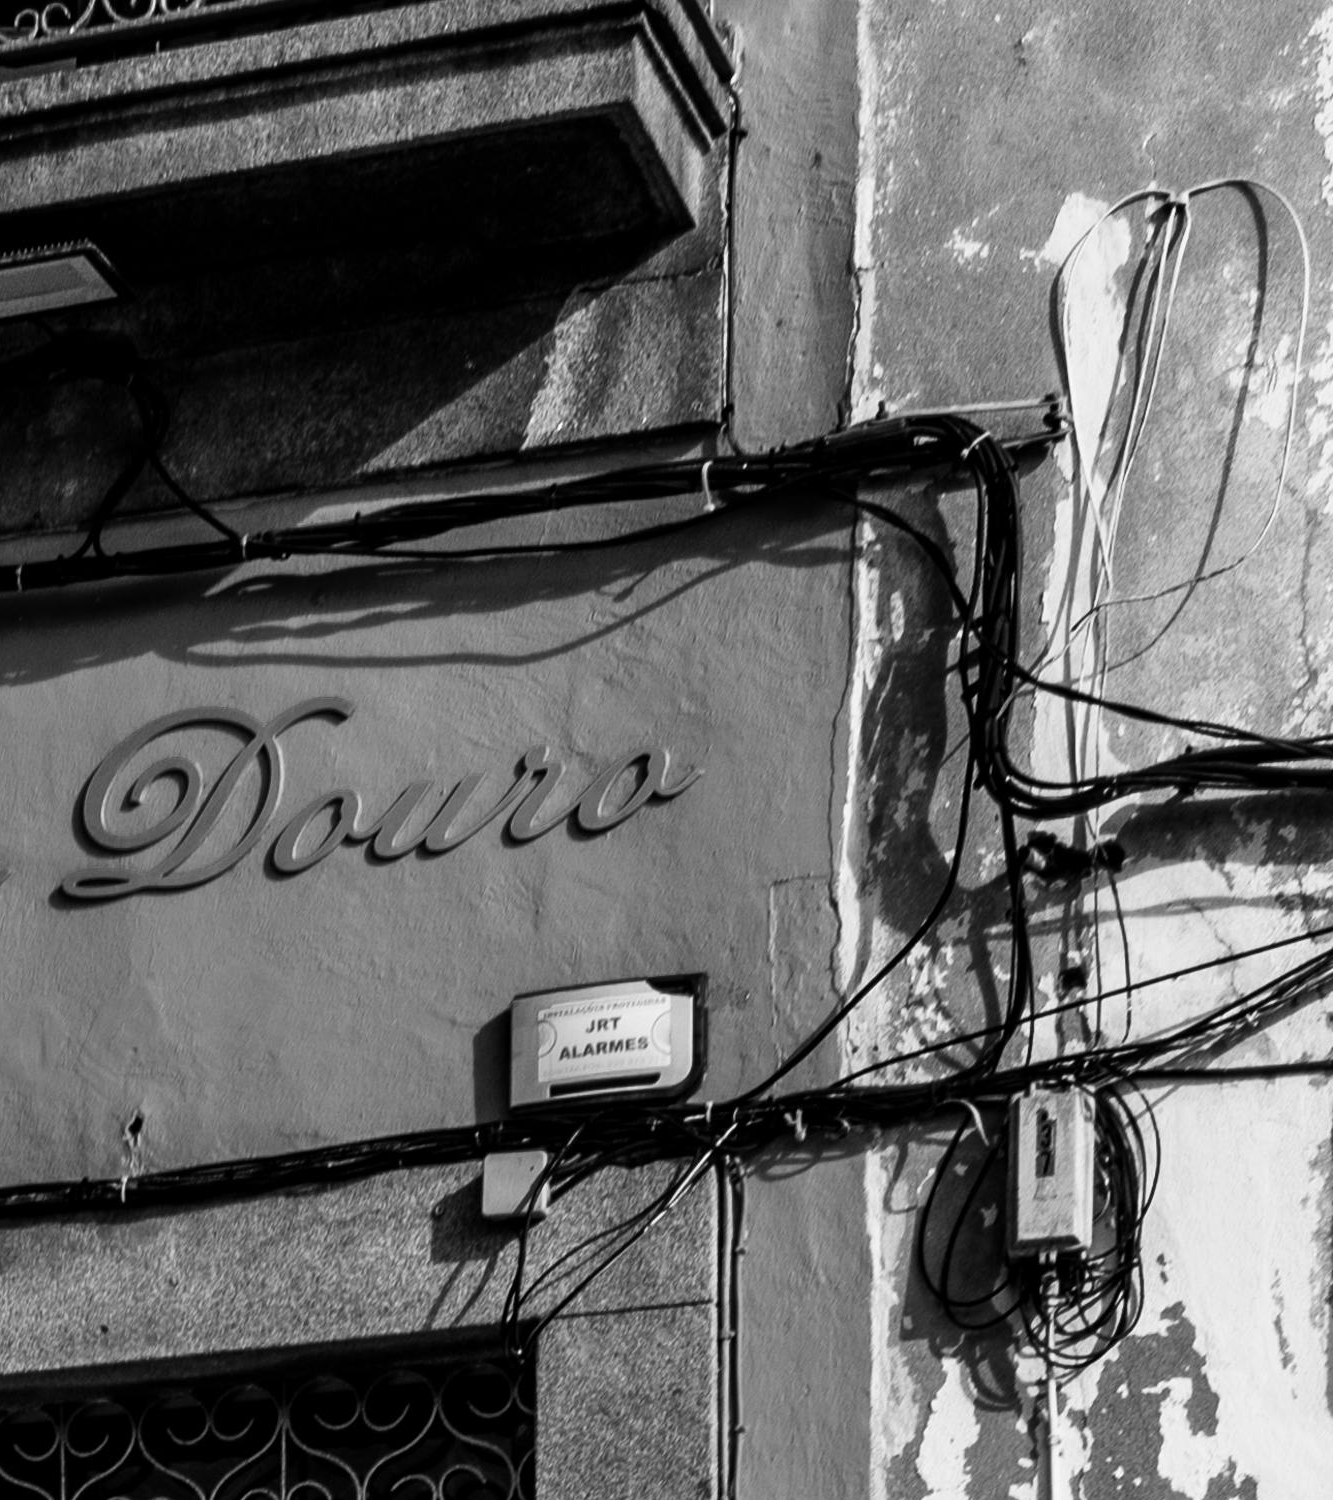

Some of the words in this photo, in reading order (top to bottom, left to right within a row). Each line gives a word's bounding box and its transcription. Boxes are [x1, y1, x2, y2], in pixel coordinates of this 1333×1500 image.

[48, 695, 707, 910] Douro
[585, 1016, 621, 1034] JRT
[558, 1036, 650, 1062] ALARMES
